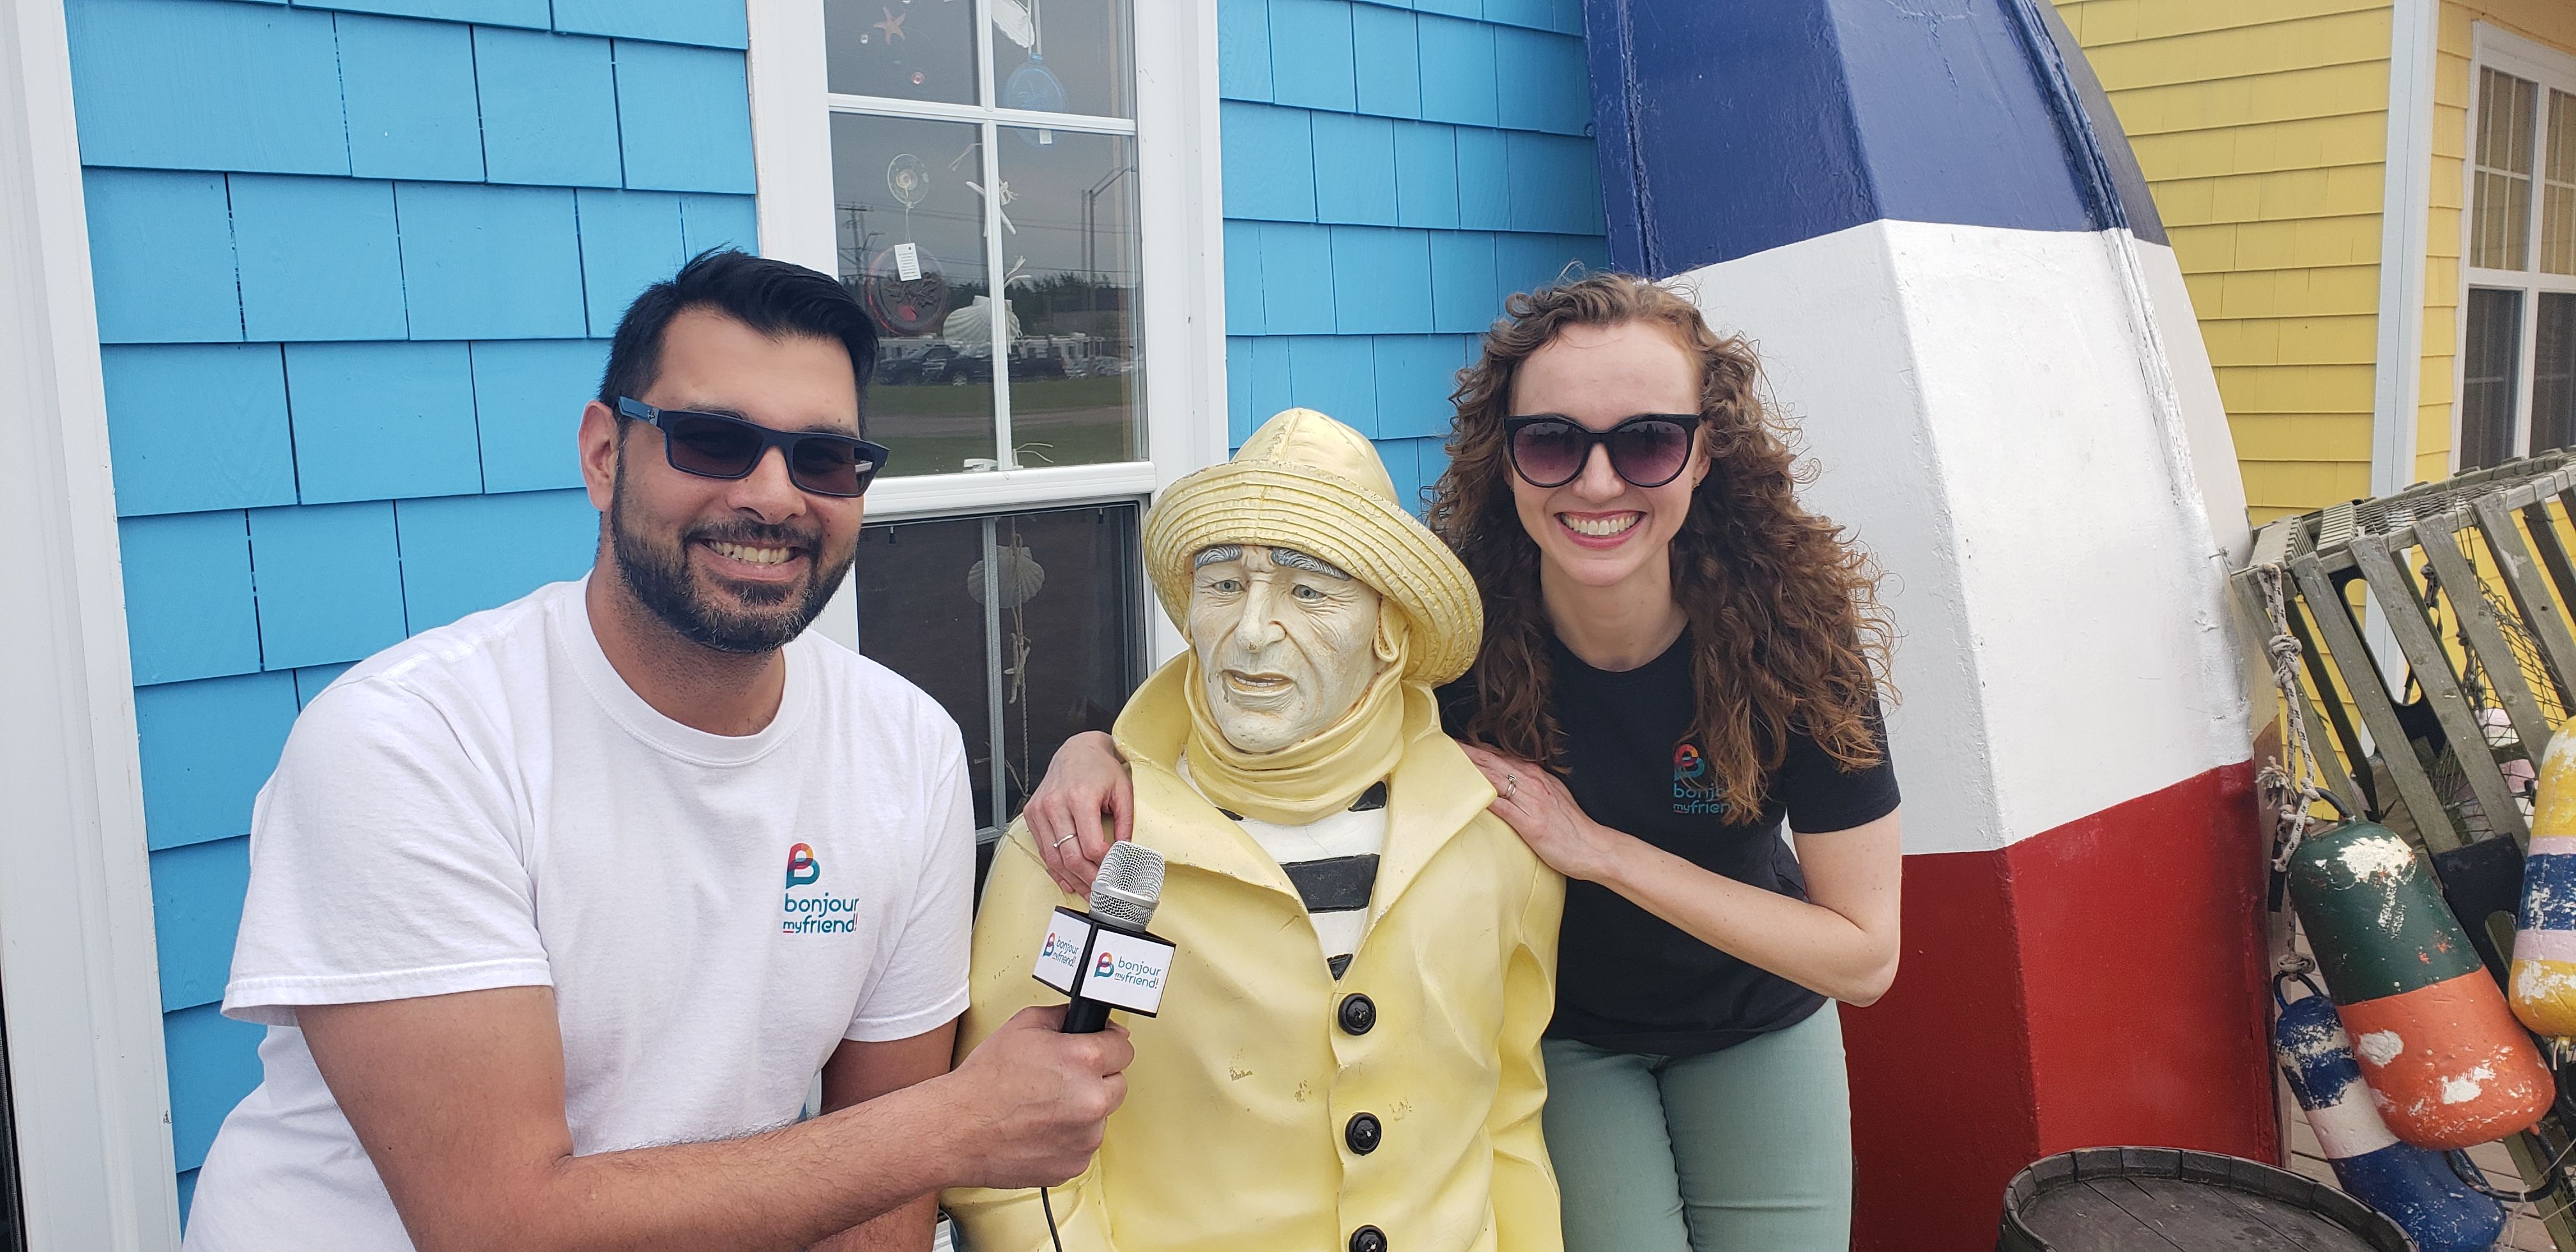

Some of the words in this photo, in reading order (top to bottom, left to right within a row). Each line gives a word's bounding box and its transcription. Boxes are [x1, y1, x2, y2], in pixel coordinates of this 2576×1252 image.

[1673, 783, 1727, 802] bonj
[785, 892, 859, 918] bonjour
[1056, 936, 1079, 955] bonjour
[1118, 956, 1162, 977] bonjour
